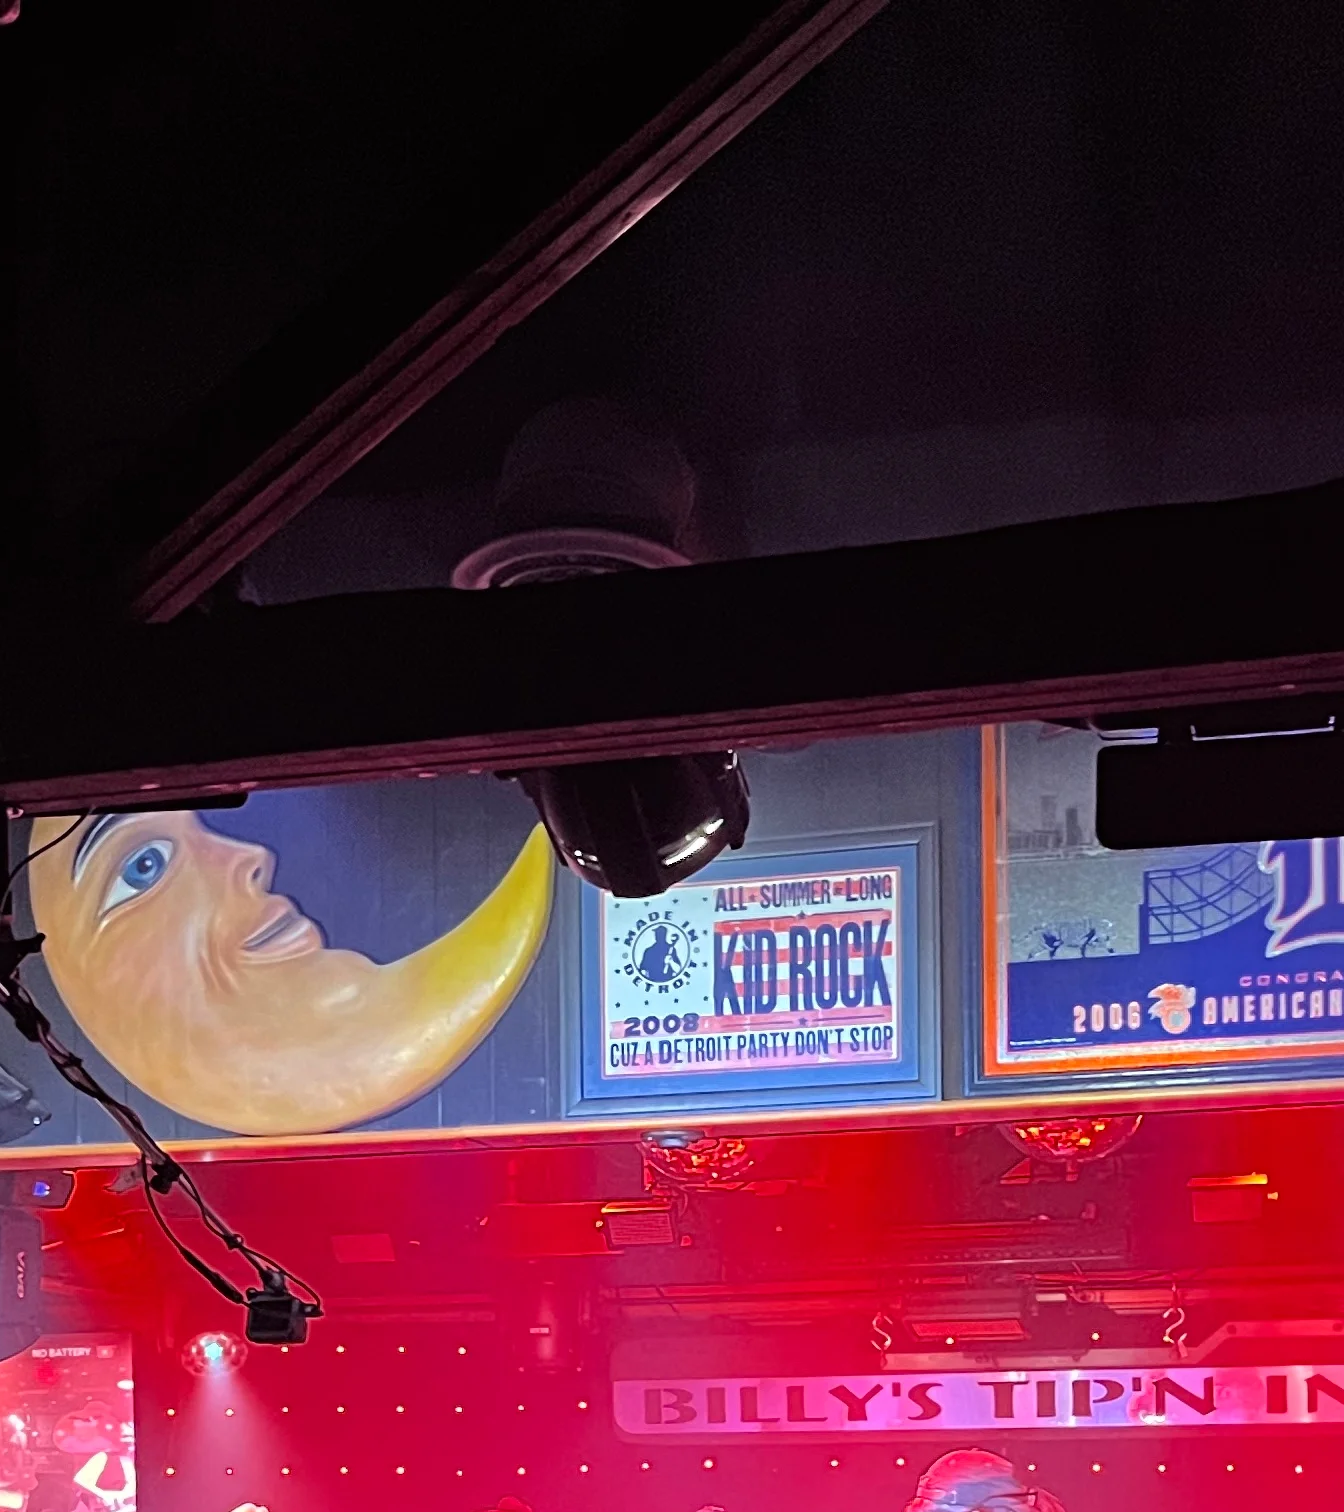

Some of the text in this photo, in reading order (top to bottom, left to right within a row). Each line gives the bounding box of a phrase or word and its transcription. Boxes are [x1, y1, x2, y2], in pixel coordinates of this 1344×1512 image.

[715, 874, 893, 912] ALL SUMMER LONG
[624, 911, 698, 947] MADE IN
[624, 960, 697, 994] DETROIT
[713, 919, 893, 1017] KID ROCK
[623, 1013, 700, 1037] 2008
[1072, 1001, 1141, 1033] 2006
[1202, 988, 1344, 1025] AMERICAN
[610, 1025, 894, 1068] CUZ A DETROIT PARTY DON'T STOP
[49, 1347, 91, 1357] BATTERY
[644, 1382, 944, 1424] BILLY'S
[976, 1376, 1217, 1418] TIP'N
